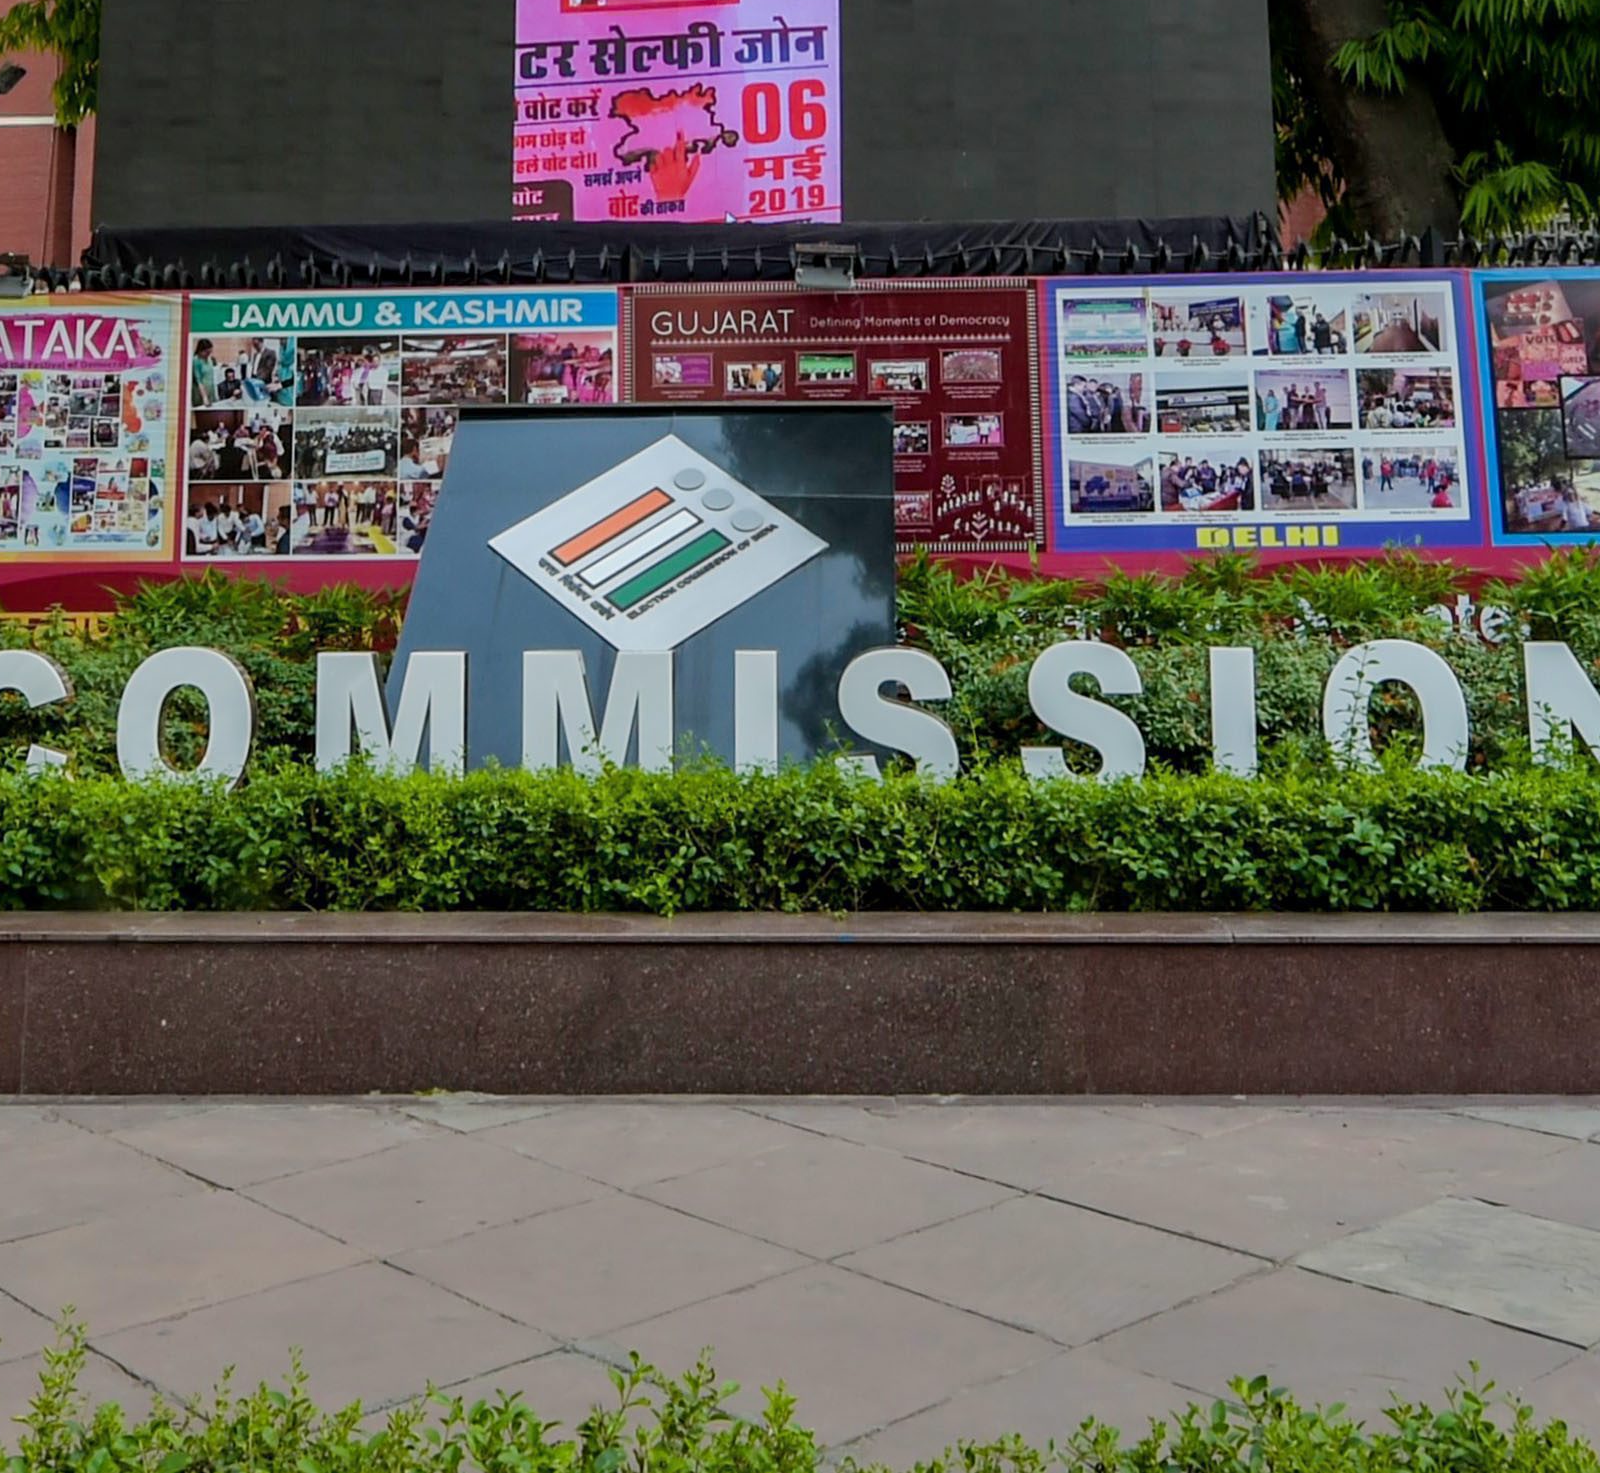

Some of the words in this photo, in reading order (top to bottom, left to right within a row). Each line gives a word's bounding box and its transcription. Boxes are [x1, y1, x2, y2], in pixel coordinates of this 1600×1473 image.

[588, 21, 725, 75] सेल्फी
[732, 16, 828, 64] जोन
[524, 92, 562, 120] वोट
[566, 88, 602, 117] करें
[741, 79, 827, 144] 06
[570, 126, 585, 146] दो
[542, 152, 567, 172] वोट
[743, 144, 827, 181] मई
[608, 189, 639, 219] वोट
[640, 199, 654, 216] की
[750, 184, 825, 213] 2019
[223, 302, 363, 328] JAMMU
[374, 301, 402, 326] &
[415, 298, 583, 325] KASHMIR
[651, 309, 795, 335] GUJARAT
[810, 316, 861, 329] Defining
[864, 315, 921, 327] Moments
[924, 314, 936, 326] of
[939, 314, 1011, 327] Democracy
[1196, 525, 1339, 548] DELHI
